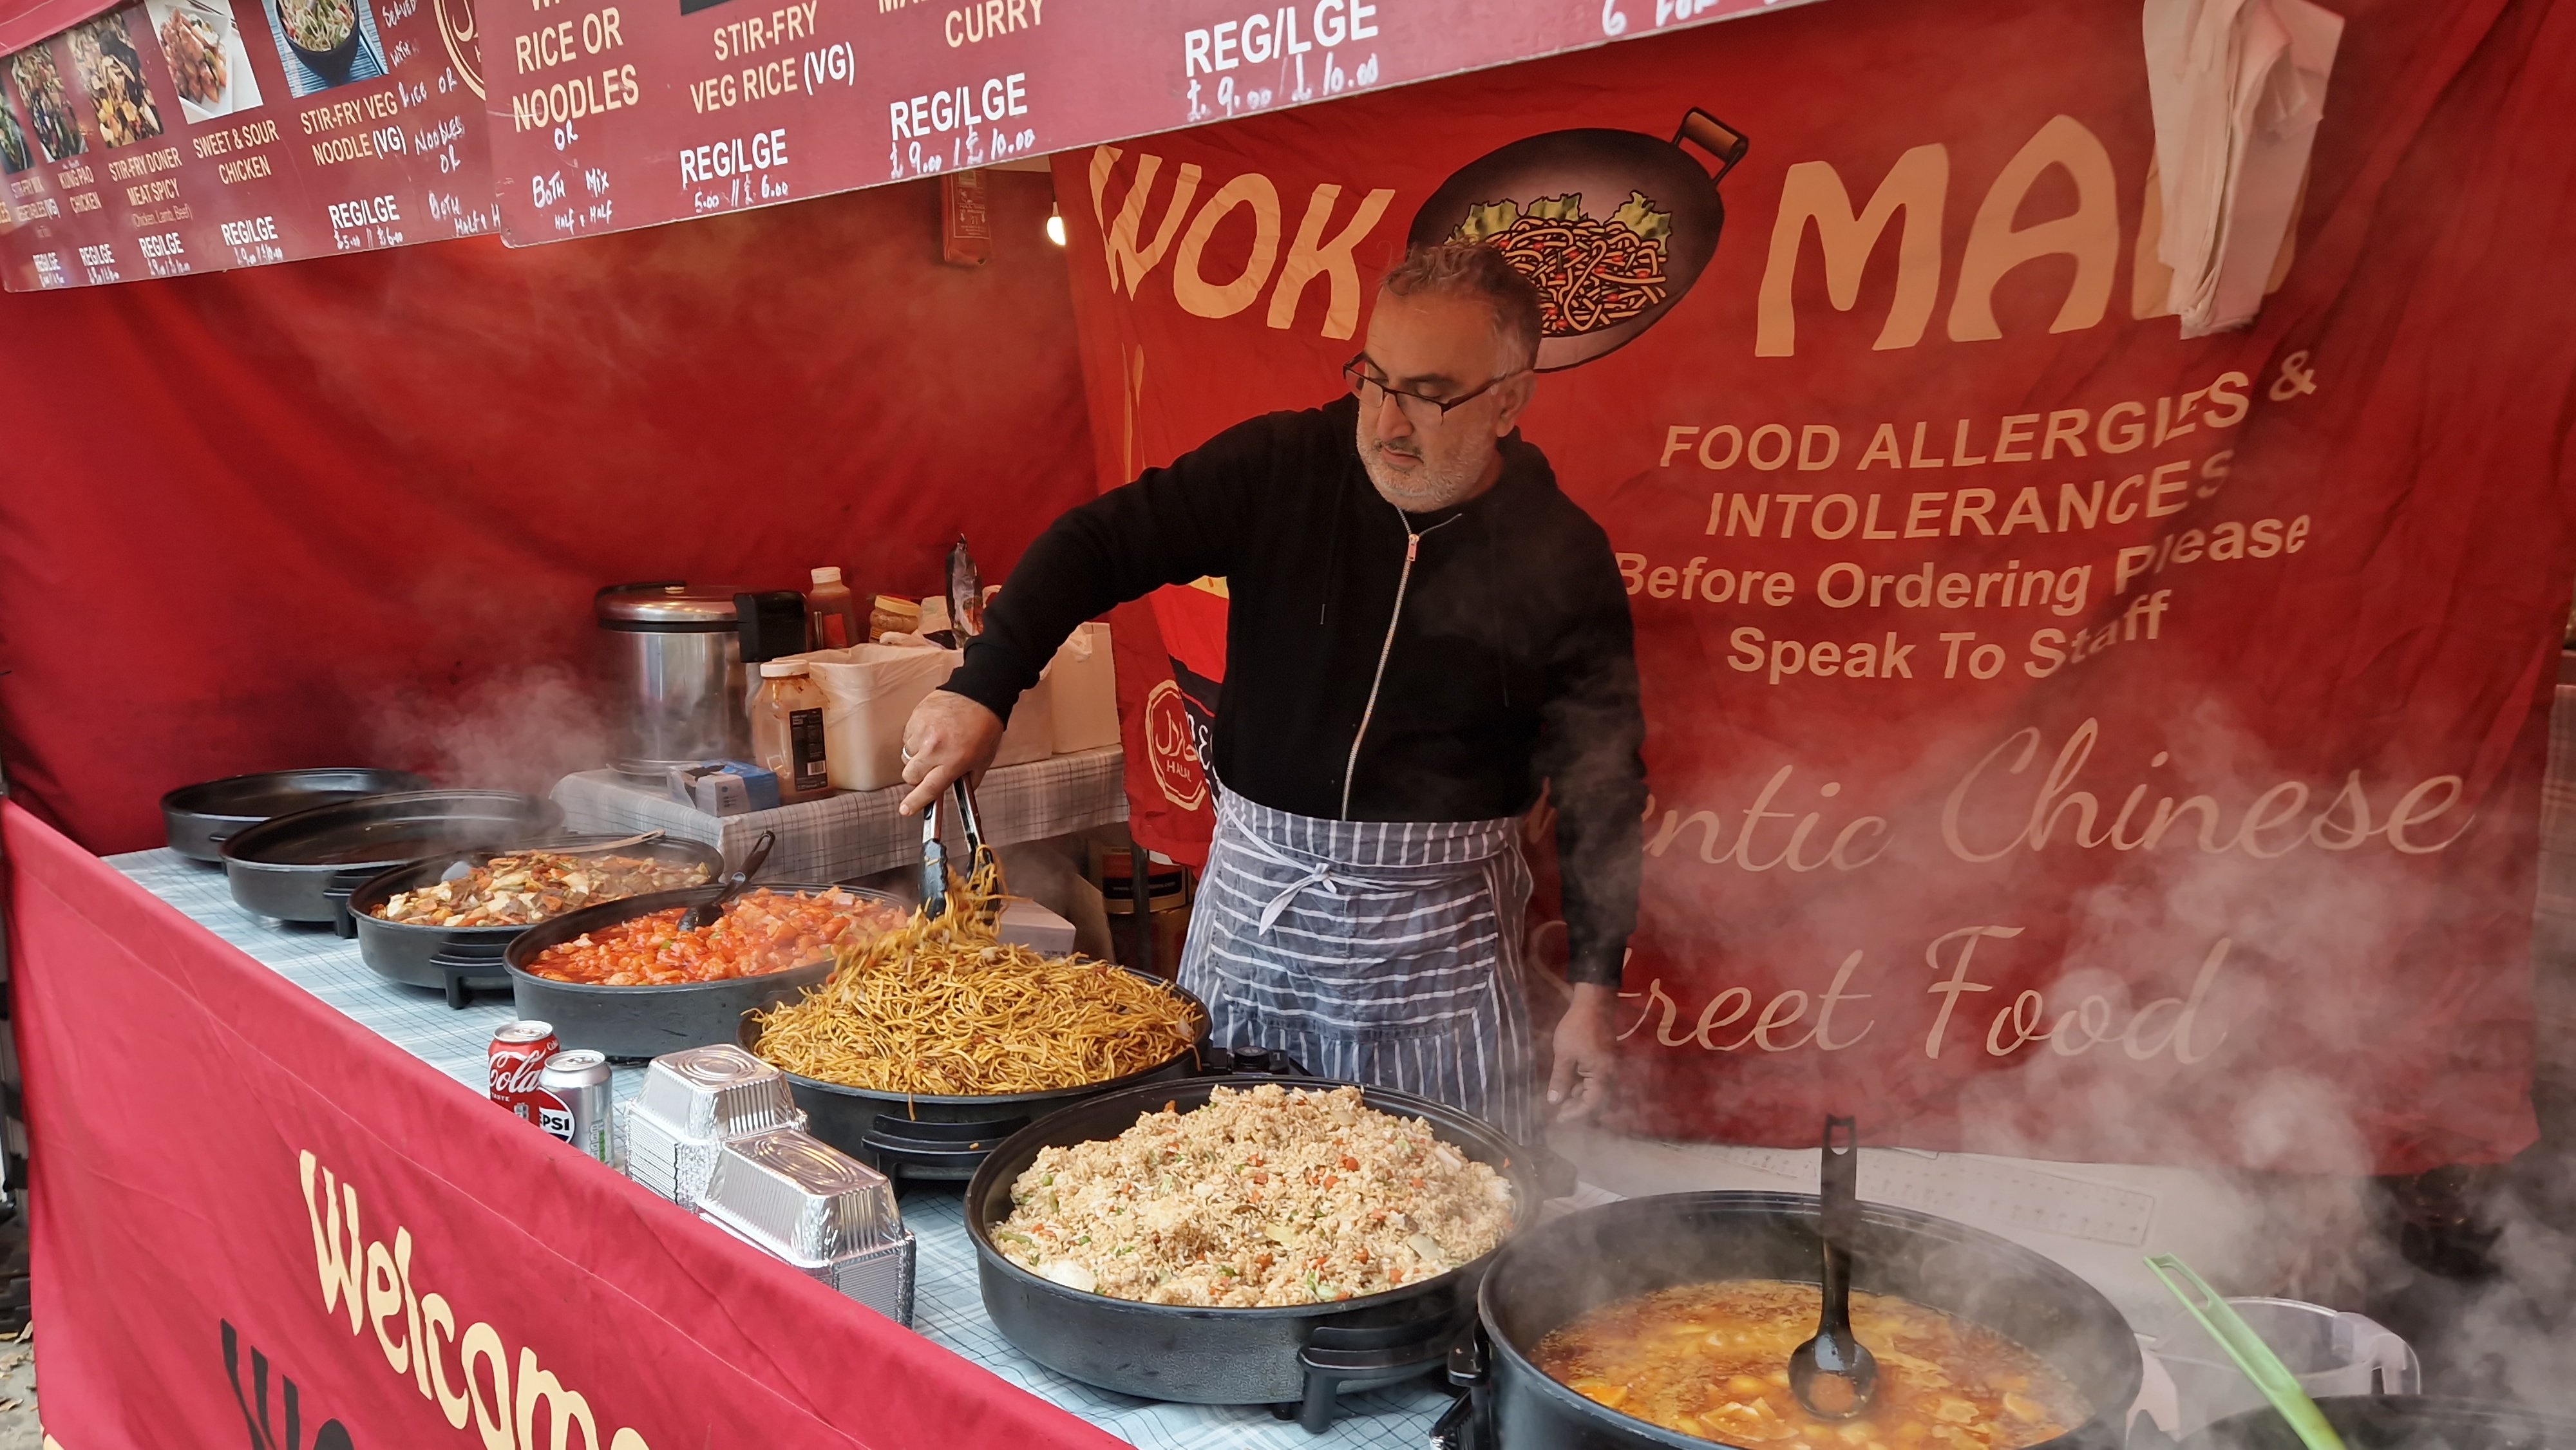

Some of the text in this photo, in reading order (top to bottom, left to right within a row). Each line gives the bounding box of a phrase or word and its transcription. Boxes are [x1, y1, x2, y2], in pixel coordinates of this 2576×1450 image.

[383, 0, 417, 28] SERVED
[713, 0, 817, 61] STIR-FRY
[945, 0, 1043, 48] CURRY
[515, 21, 577, 75] RICE
[582, 7, 624, 55] OR
[1184, 0, 1379, 78] REG/LGE
[398, 66, 459, 108] RICE OR
[512, 64, 640, 133] NOODLES
[690, 41, 855, 114] VEG RICE (VG)
[300, 91, 399, 135] STIR-FRY VEG
[889, 72, 1028, 142] REG/LGE
[193, 120, 280, 159] SWEET & SOUR
[312, 124, 407, 166] NOODLE (VG)
[554, 118, 579, 151] OR
[679, 128, 789, 183] REG/LGE
[108, 155, 147, 182] STIR-FRY
[146, 147, 183, 173] DONER
[218, 154, 272, 185] CHICKEN
[439, 144, 461, 174] OR
[70, 191, 102, 214] CHICKEN
[126, 178, 180, 207] MEAT SPICY
[328, 194, 401, 230] REG/LGE
[531, 169, 566, 209] BOTH
[138, 232, 185, 258] REG/LGE
[221, 216, 279, 246] REG/LGE
[1089, 143, 1396, 341] WOK
[1659, 350, 2317, 474] FOOD ALLERGIES &
[1703, 448, 2236, 541] INTOLERANCES
[1615, 514, 2311, 616] Before Ordering Please
[1726, 588, 2173, 685] Speak To Staff
[1940, 716, 2479, 864] Chinese
[1926, 924, 2236, 1066] Food
[299, 1149, 650, 1450] Welcom
